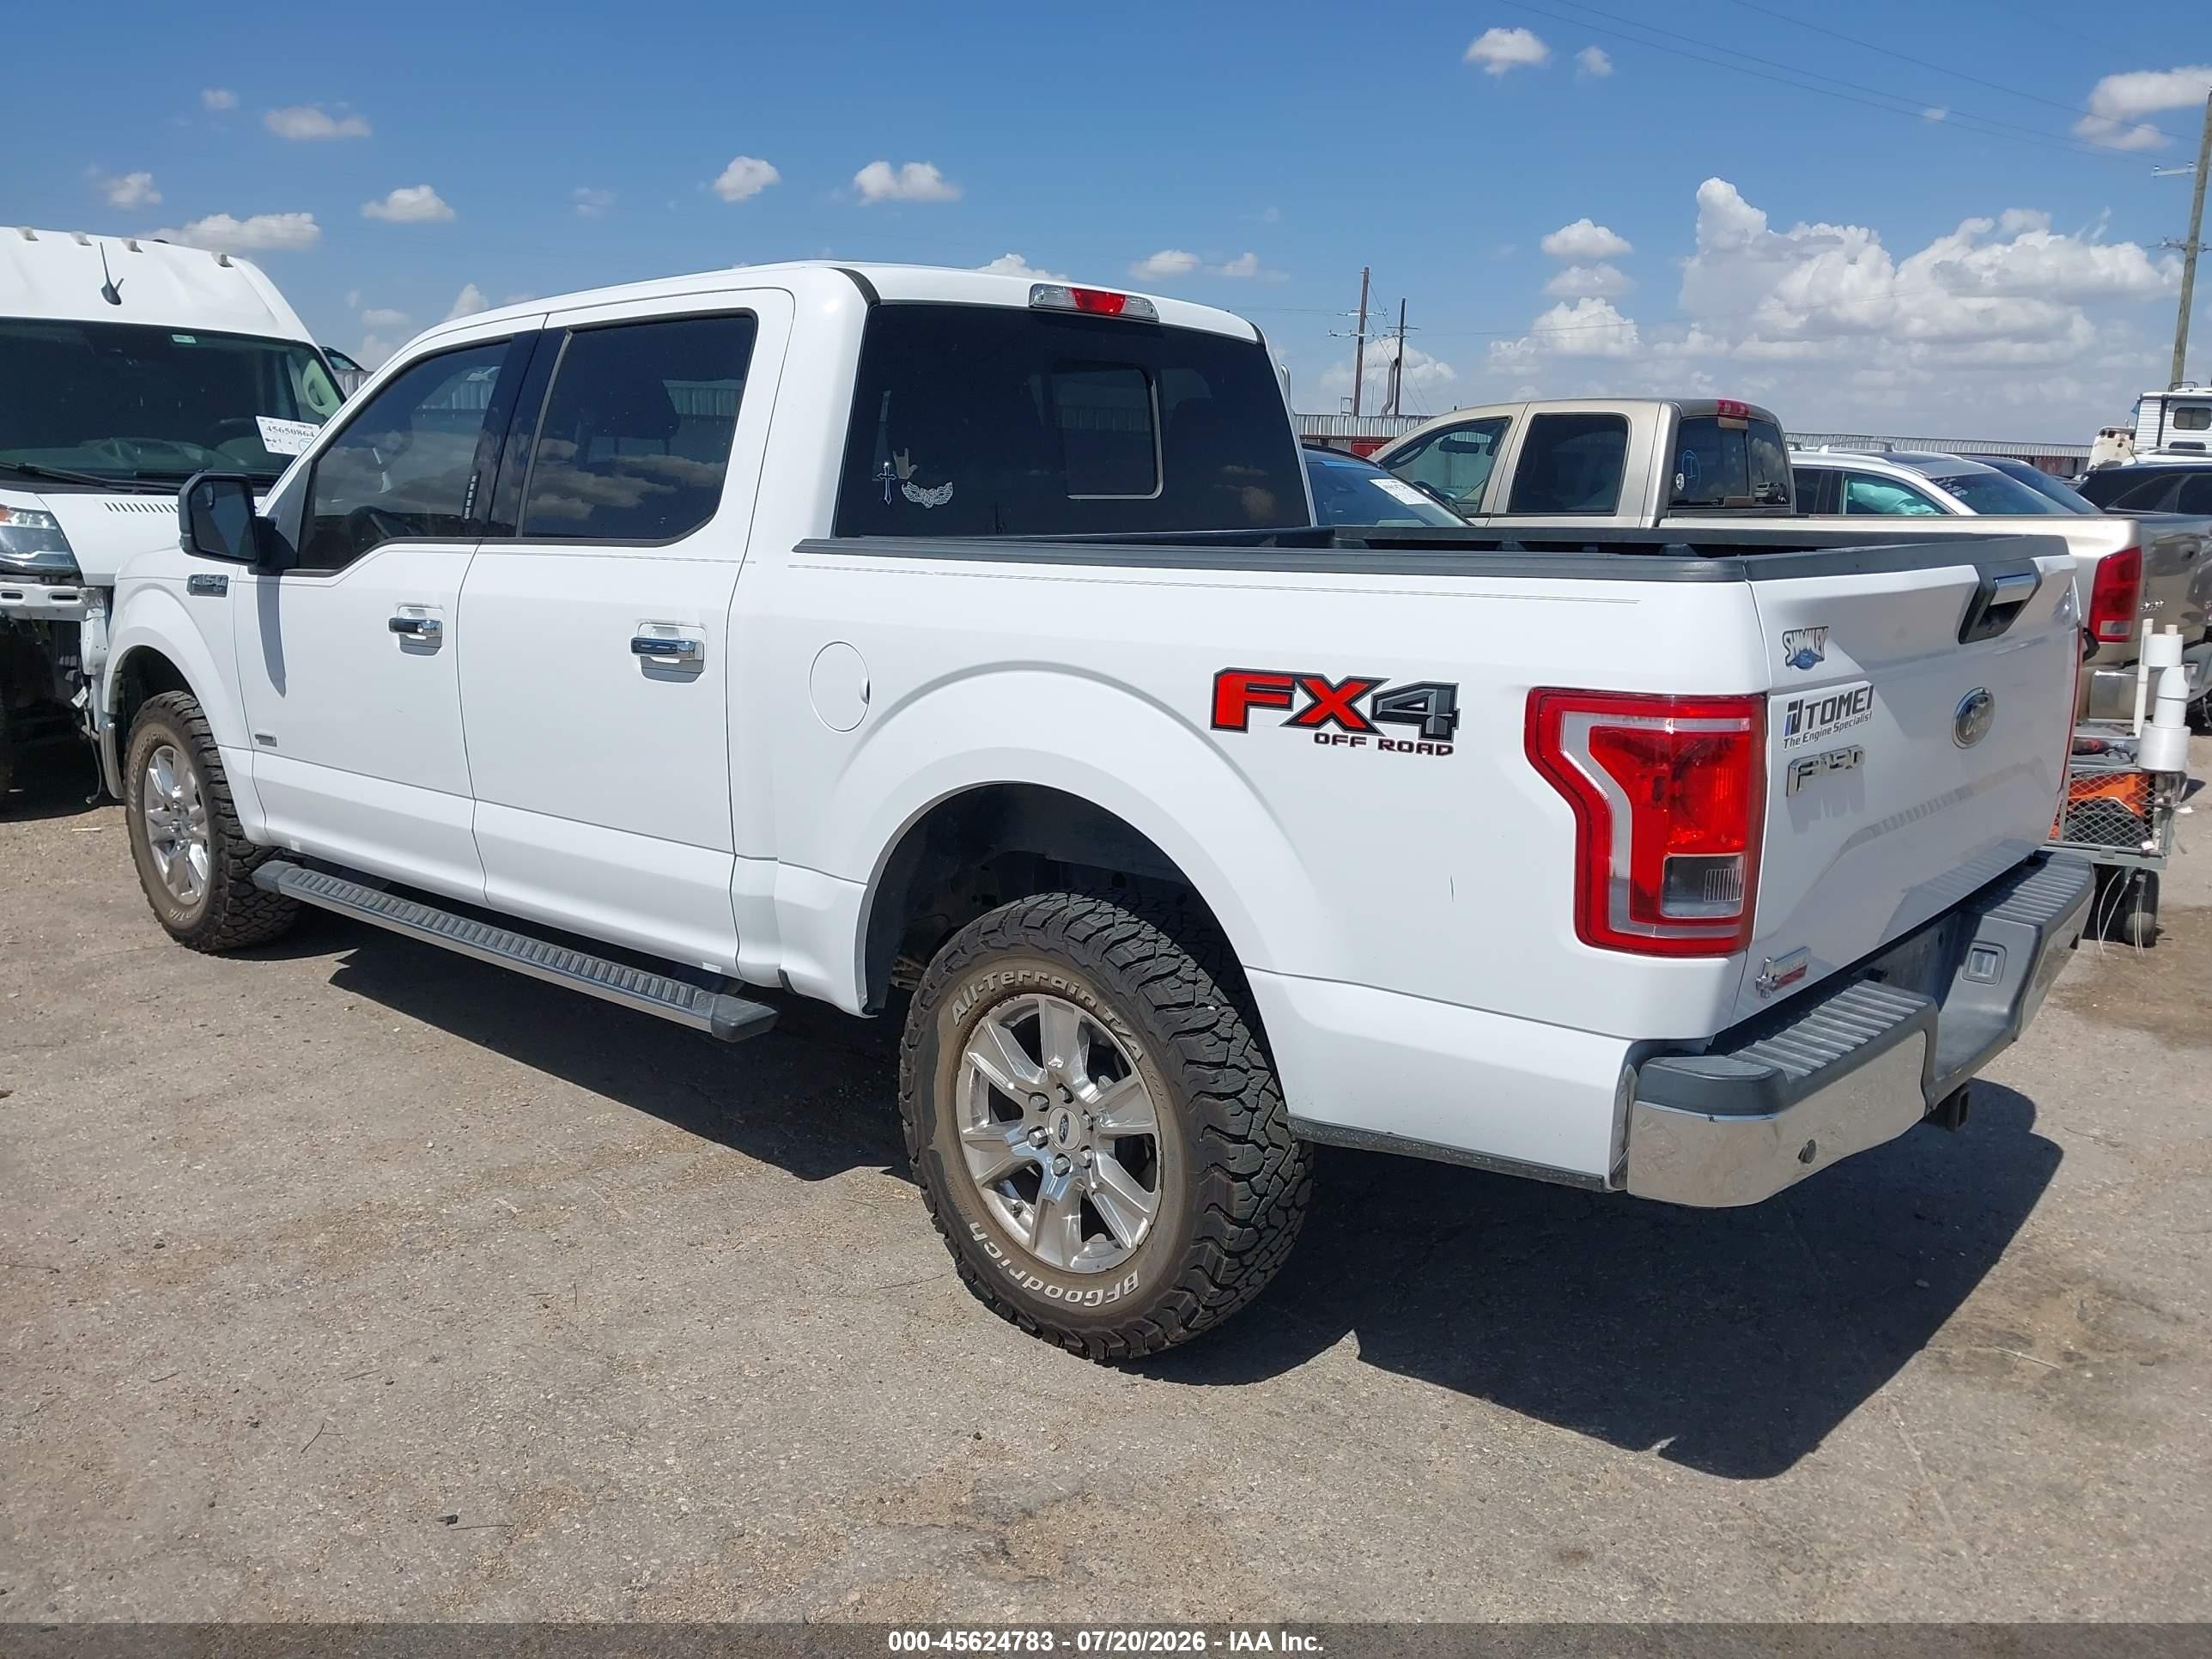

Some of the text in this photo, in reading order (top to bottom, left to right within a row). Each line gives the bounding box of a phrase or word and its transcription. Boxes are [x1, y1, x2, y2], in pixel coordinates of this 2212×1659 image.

[1210, 666, 1461, 744] FX4
[1784, 710, 1873, 749] The Engine Specialist
[1314, 731, 1455, 757] OFF ROAD
[951, 969, 1097, 1026] All-Terrain
[969, 1221, 1140, 1308] BFGoodrich
